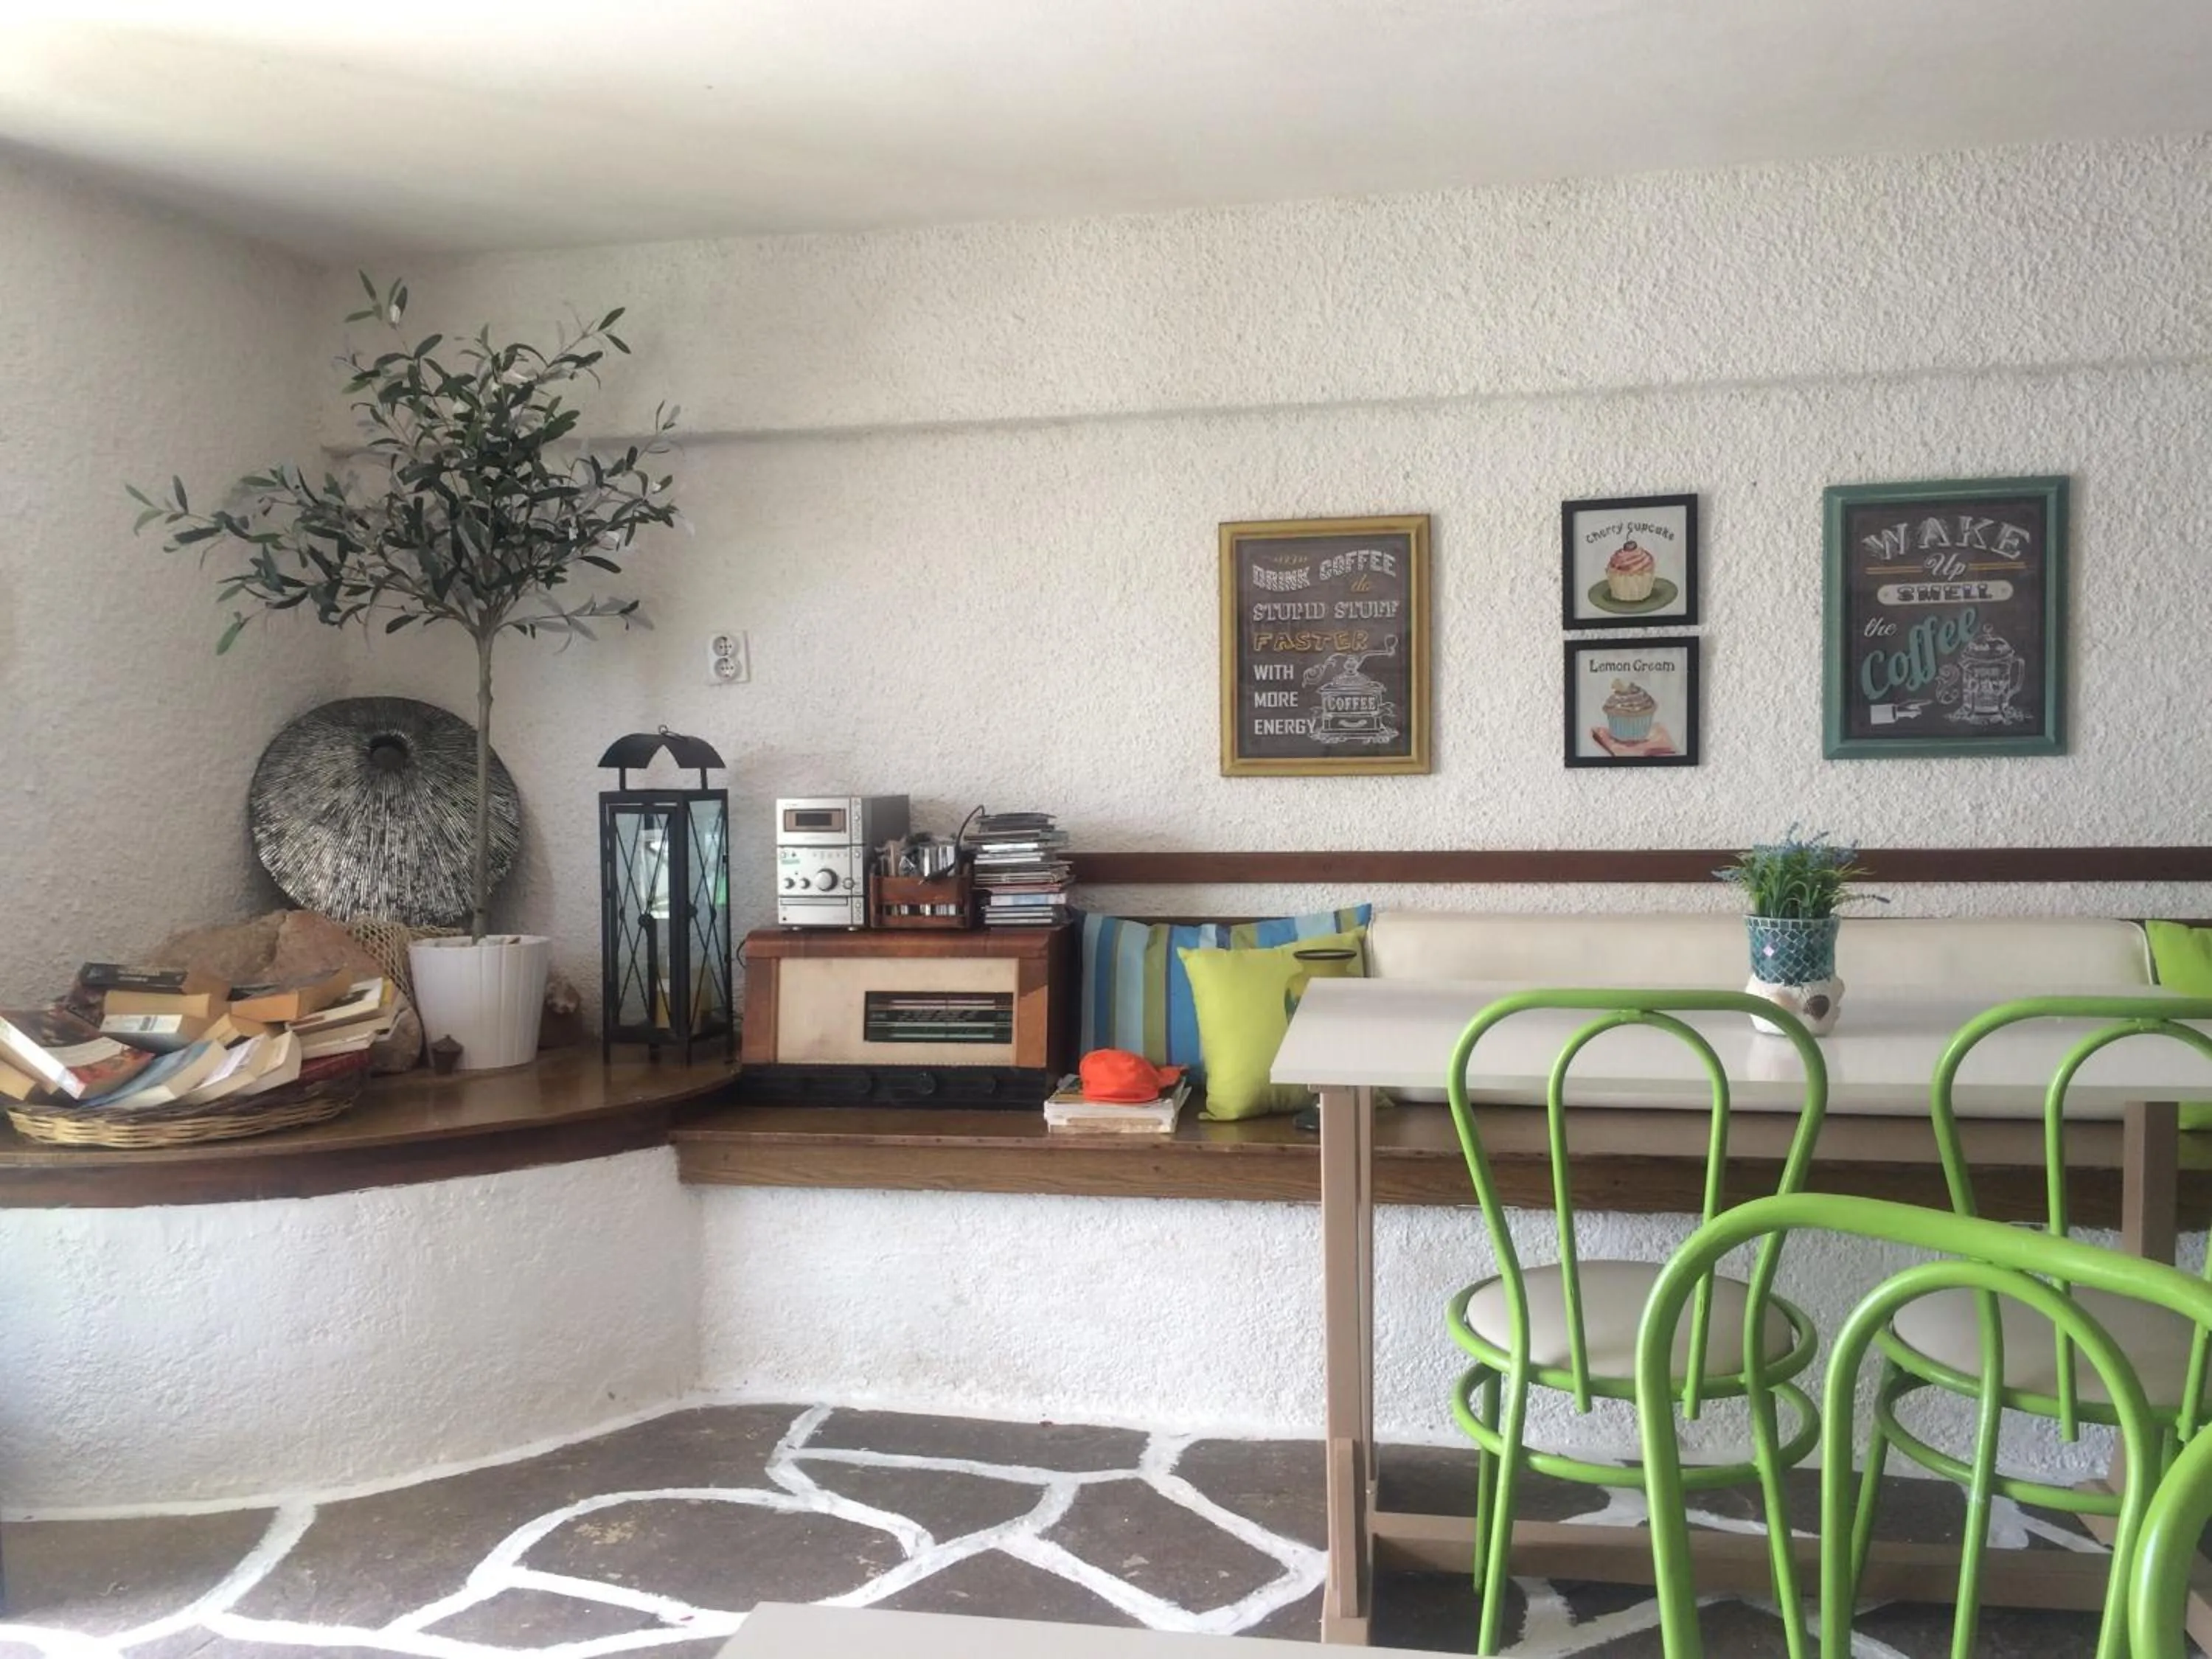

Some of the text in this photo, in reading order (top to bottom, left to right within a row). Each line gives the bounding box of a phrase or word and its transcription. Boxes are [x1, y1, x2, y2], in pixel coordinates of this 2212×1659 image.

[1862, 516, 2031, 560] WAKE
[1253, 564, 1310, 591] DRINK
[1319, 549, 1397, 581] COFFEE
[1924, 553, 1966, 580] Up
[1896, 583, 1994, 602] SMELL
[1253, 600, 1399, 622] STUPID STUFF
[1864, 616, 1898, 637] the
[1253, 630, 1369, 651] FASTER
[1860, 606, 1979, 700] Coffee
[1253, 664, 1294, 681] WITH
[1590, 658, 1675, 672] Lemon Cream
[1254, 691, 1298, 709] MORE
[1328, 697, 1376, 711] COFFEE
[1254, 719, 1316, 734] ENERGY
